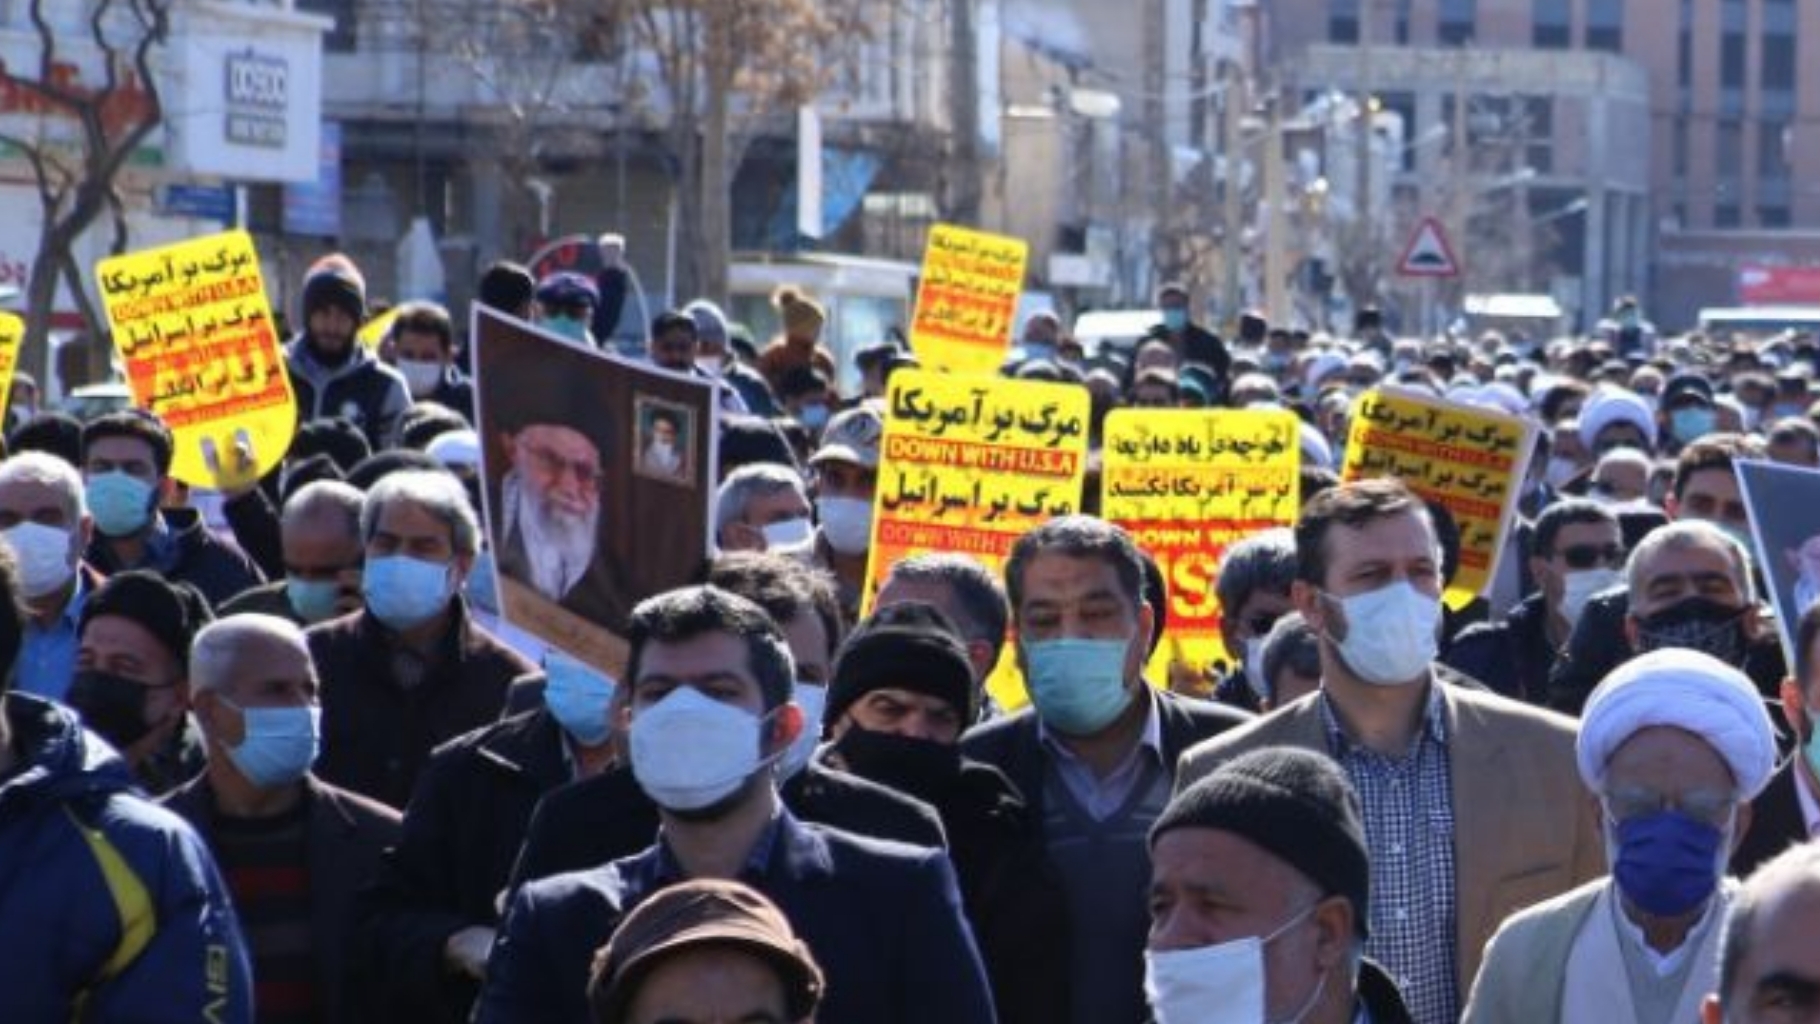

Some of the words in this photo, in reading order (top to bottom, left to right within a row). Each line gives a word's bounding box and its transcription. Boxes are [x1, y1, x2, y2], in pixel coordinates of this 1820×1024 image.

[892, 386, 990, 435] آمریکا
[984, 409, 1014, 441] بر
[1019, 401, 1080, 448] مرگ
[981, 493, 1009, 522] بر
